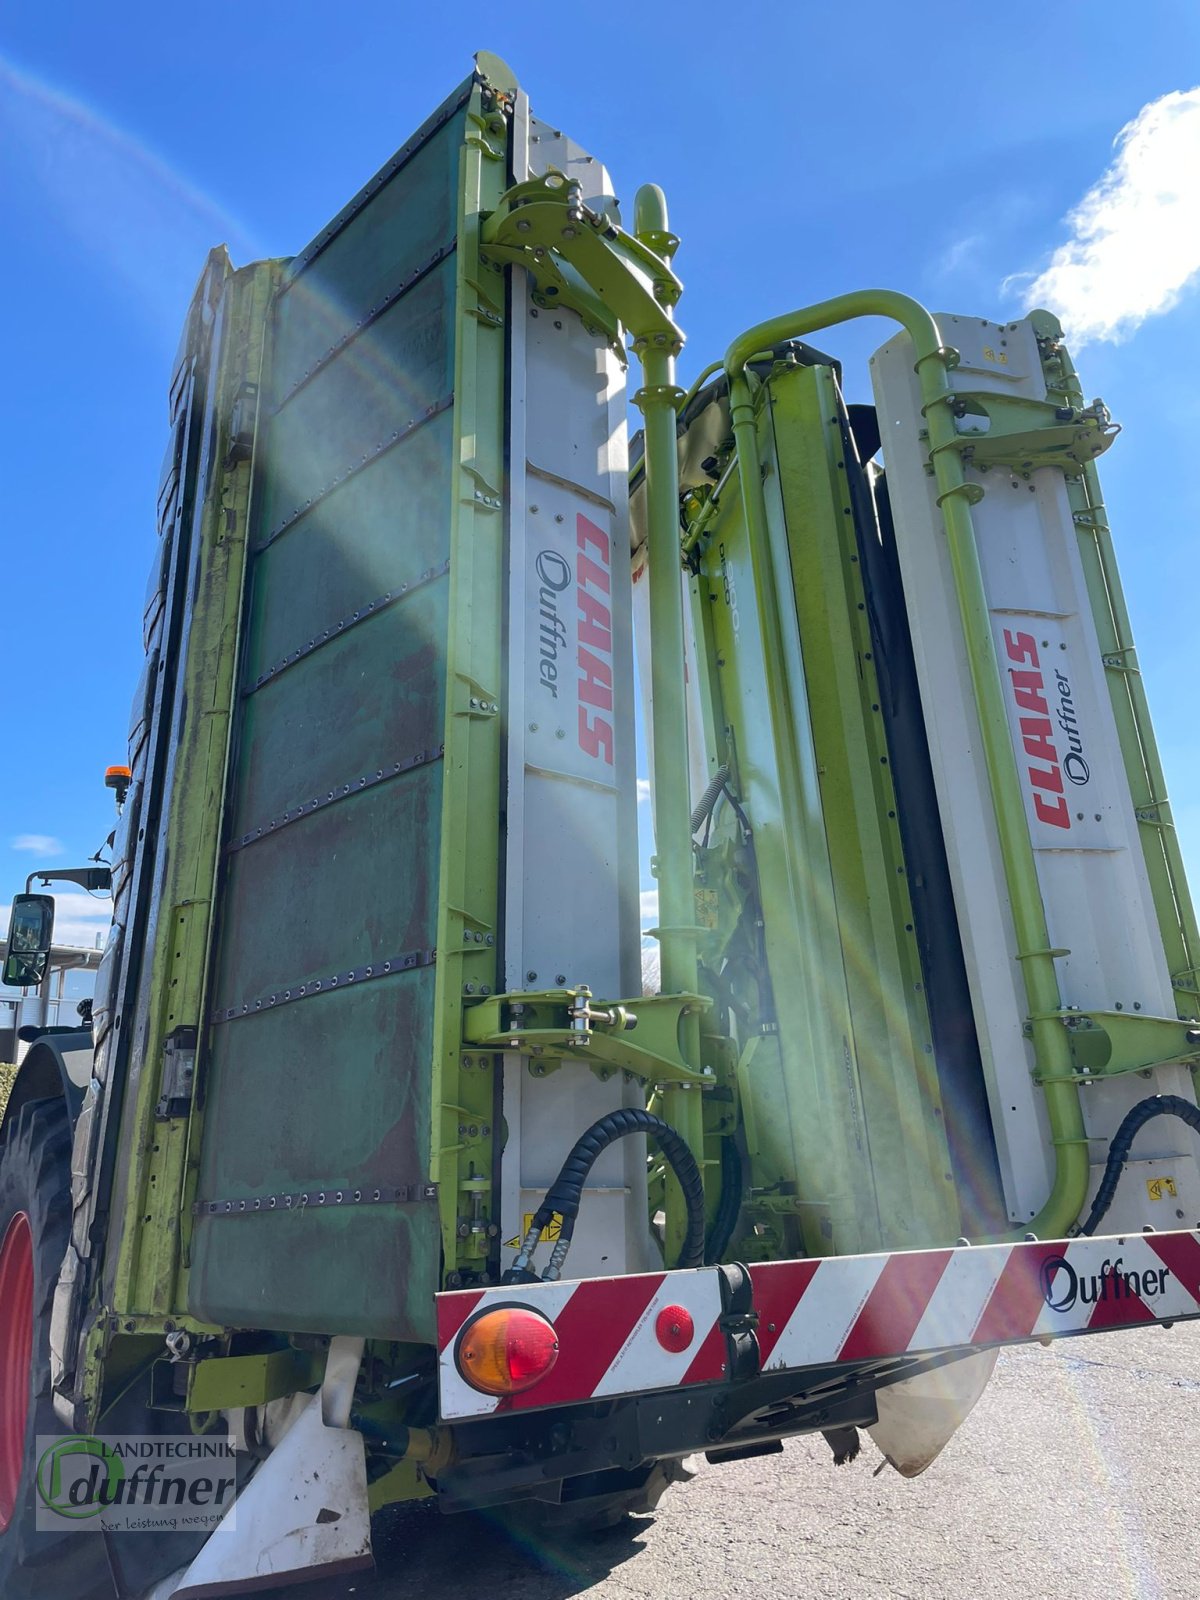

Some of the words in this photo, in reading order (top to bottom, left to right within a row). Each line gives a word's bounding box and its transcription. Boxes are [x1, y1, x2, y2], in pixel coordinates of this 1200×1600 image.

[535, 550, 571, 698] Duffner
[576, 512, 614, 766] CLAAS
[719, 542, 731, 605] DISCO
[1003, 629, 1071, 829] CLAAS
[1054, 669, 1090, 785] Duffner
[1040, 1254, 1170, 1313] Duffner
